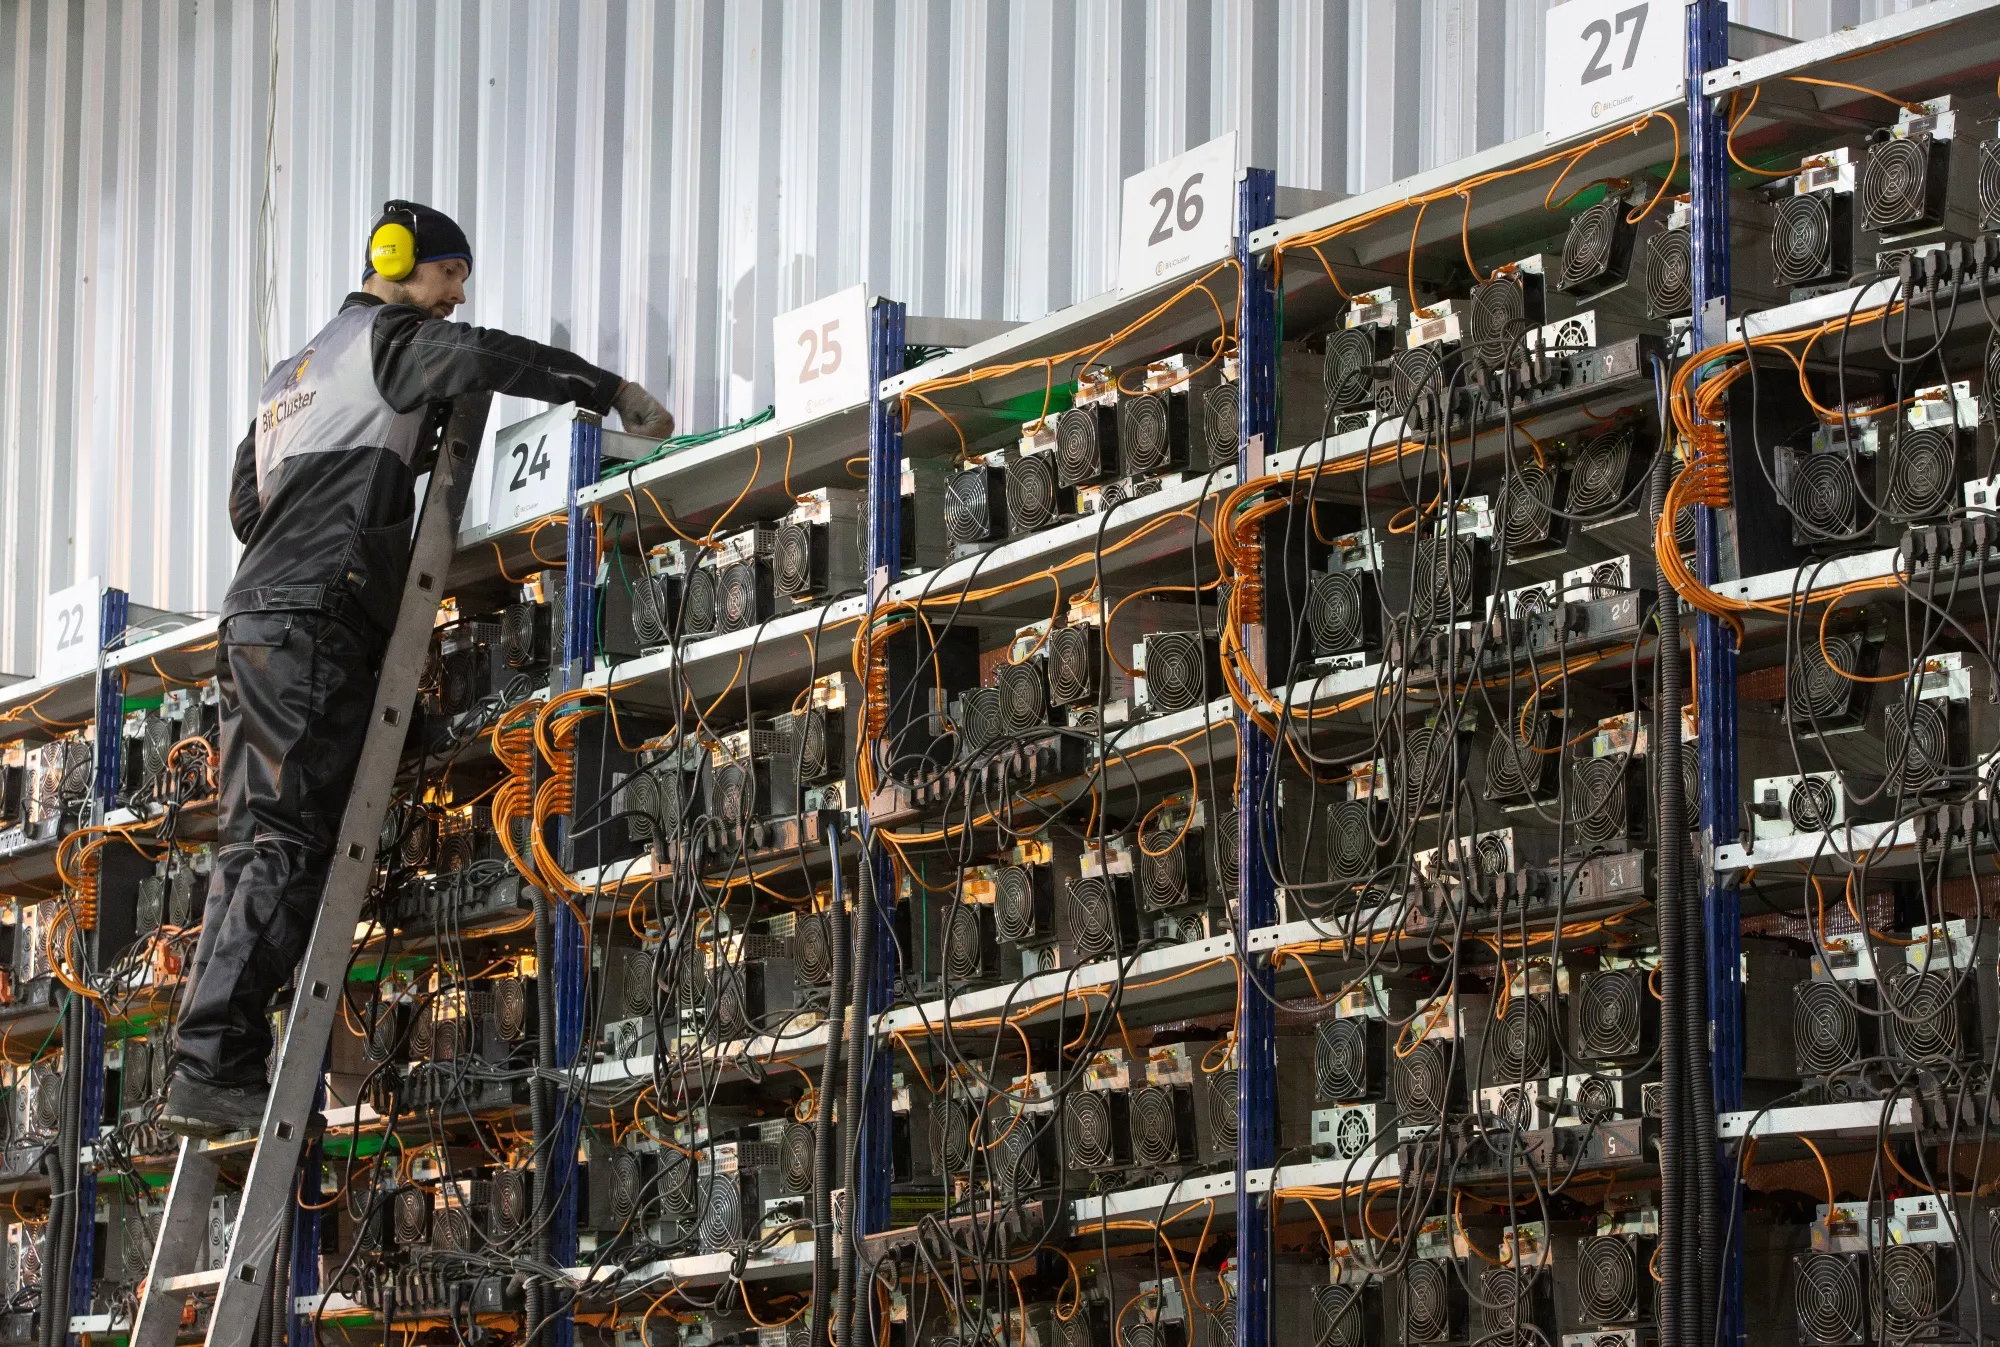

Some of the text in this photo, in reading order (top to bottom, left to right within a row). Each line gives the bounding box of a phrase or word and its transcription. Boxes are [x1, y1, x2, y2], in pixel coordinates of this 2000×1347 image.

[1580, 2, 1649, 86] 27
[1602, 95, 1634, 111] Bit Cluster
[1147, 172, 1204, 248] 26
[798, 318, 842, 385] 25
[262, 390, 317, 434] Bit Cluster
[509, 433, 551, 492] 24
[57, 603, 84, 652] 22
[1611, 599, 1631, 621] 20
[1610, 864, 1624, 887] 21
